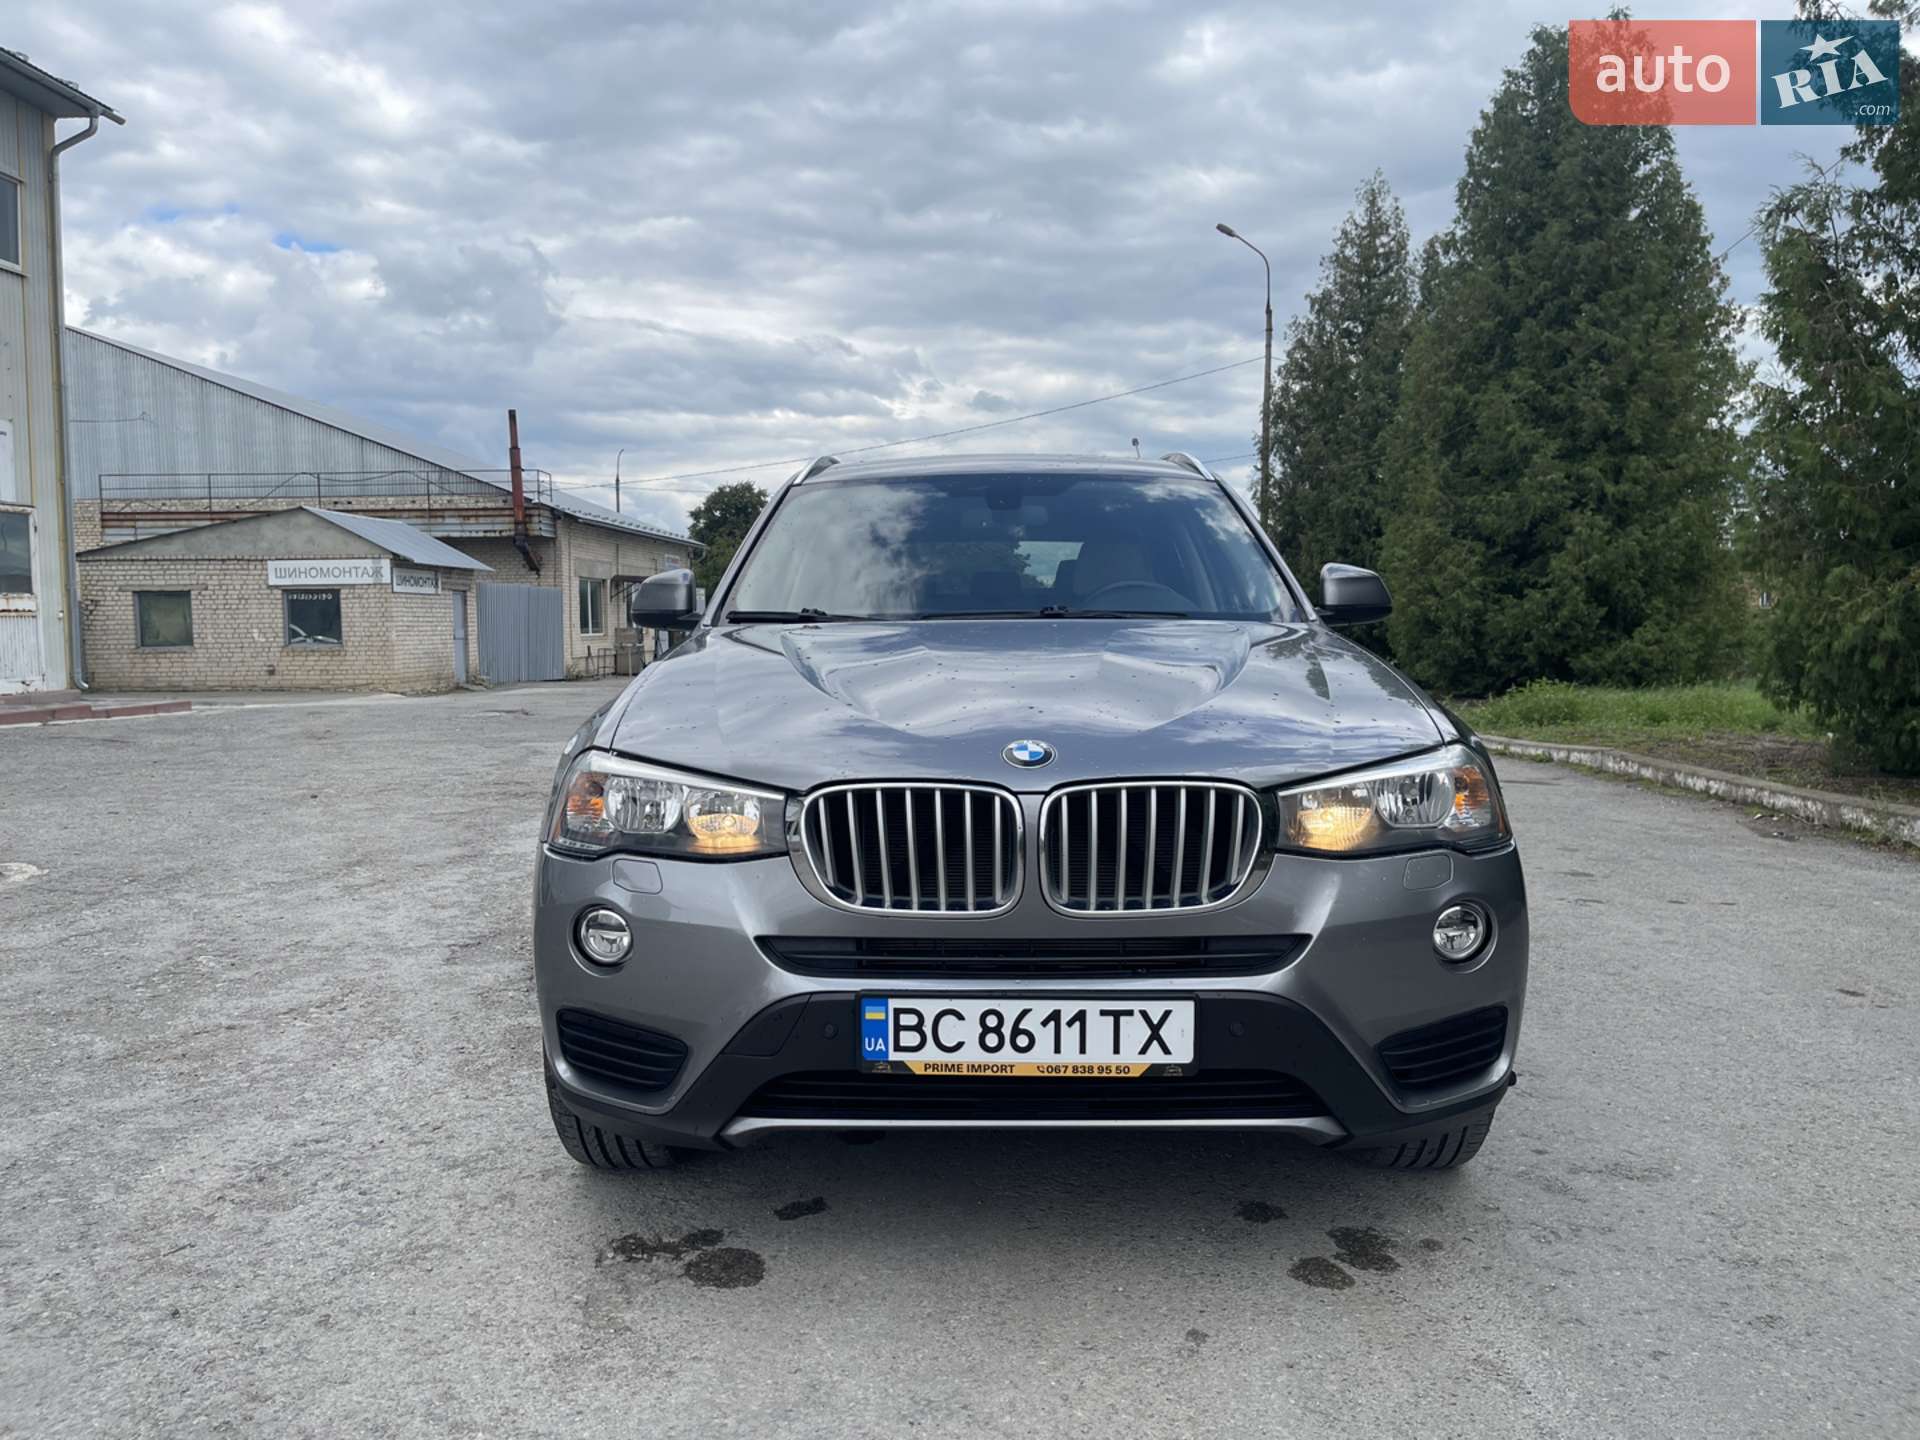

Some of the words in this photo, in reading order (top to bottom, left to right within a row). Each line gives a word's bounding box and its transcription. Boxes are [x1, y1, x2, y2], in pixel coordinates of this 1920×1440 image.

[274, 566, 384, 580] ШИНОМОНТАЖ
[893, 1007, 966, 1053] BC
[978, 1008, 1087, 1055] 8611
[1099, 1009, 1173, 1055] TX
[865, 1037, 886, 1051] UA
[924, 1063, 963, 1073] PRIME
[966, 1063, 1016, 1074] IMPORT
[1046, 1065, 1069, 1075] 067
[1072, 1065, 1094, 1075] 838
[1097, 1065, 1112, 1075] 95
[1115, 1065, 1131, 1075] 50
